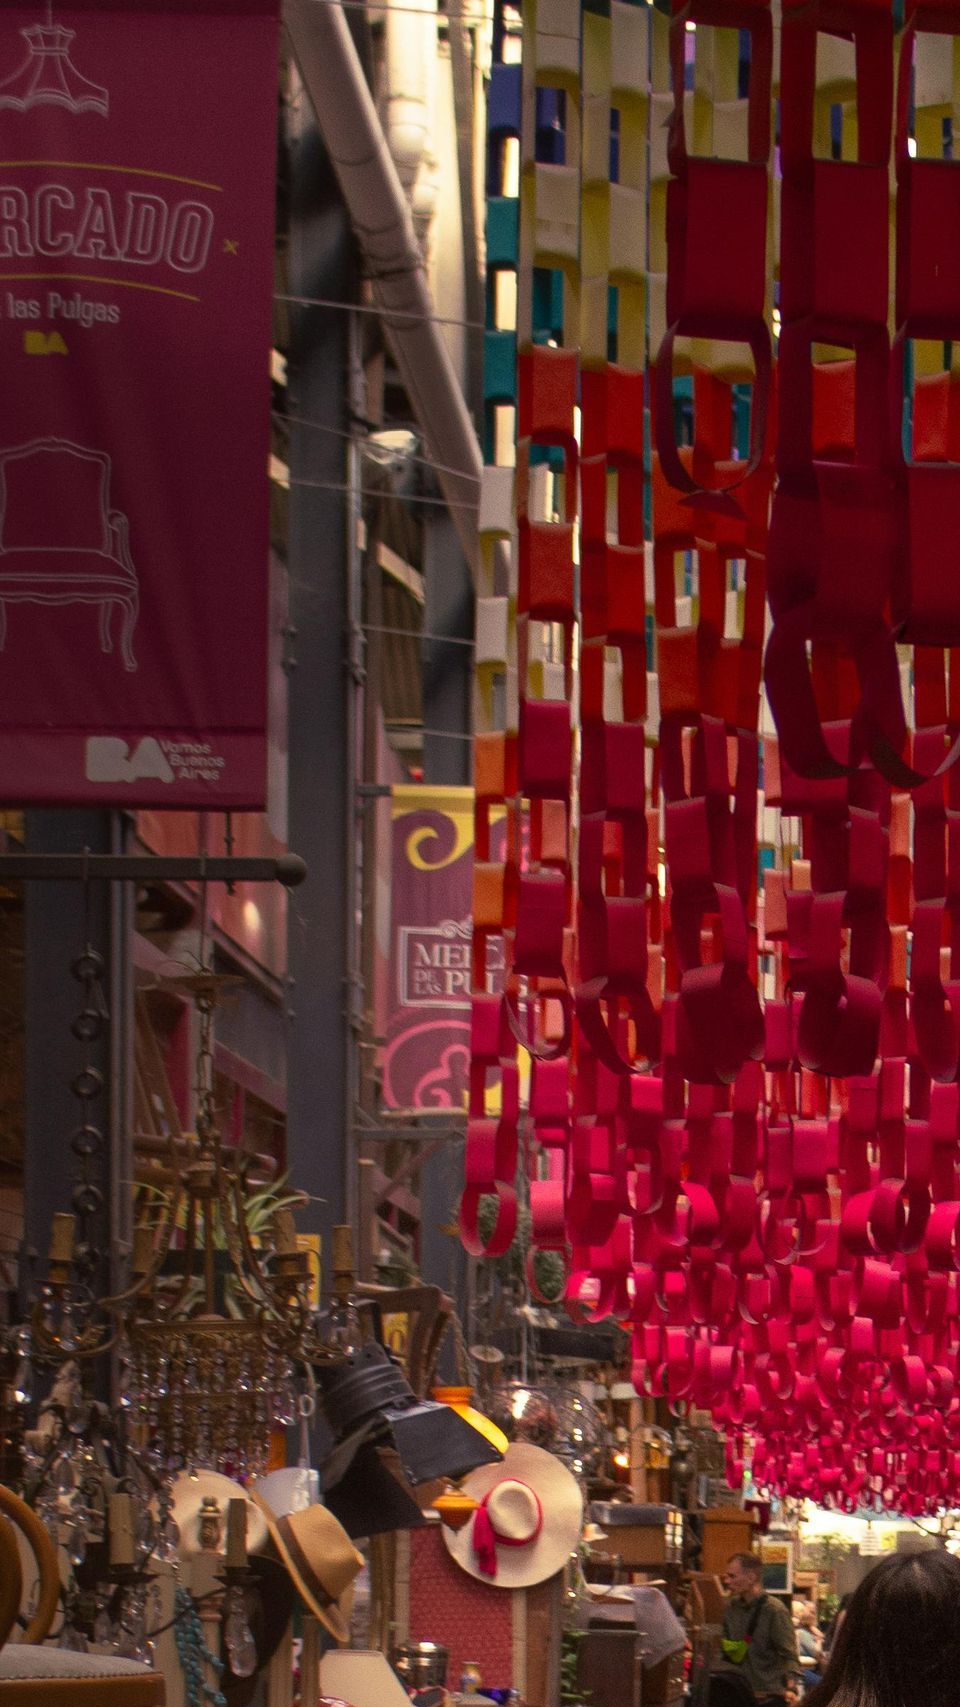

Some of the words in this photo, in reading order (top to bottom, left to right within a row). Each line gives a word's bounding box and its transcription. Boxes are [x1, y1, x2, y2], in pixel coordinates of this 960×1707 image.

[6, 292, 41, 319] las
[49, 292, 120, 328] Pulgas
[158, 738, 211, 755] Vamos
[85, 735, 175, 783] BA
[169, 753, 225, 768] Buenos
[178, 766, 220, 781] Aires
